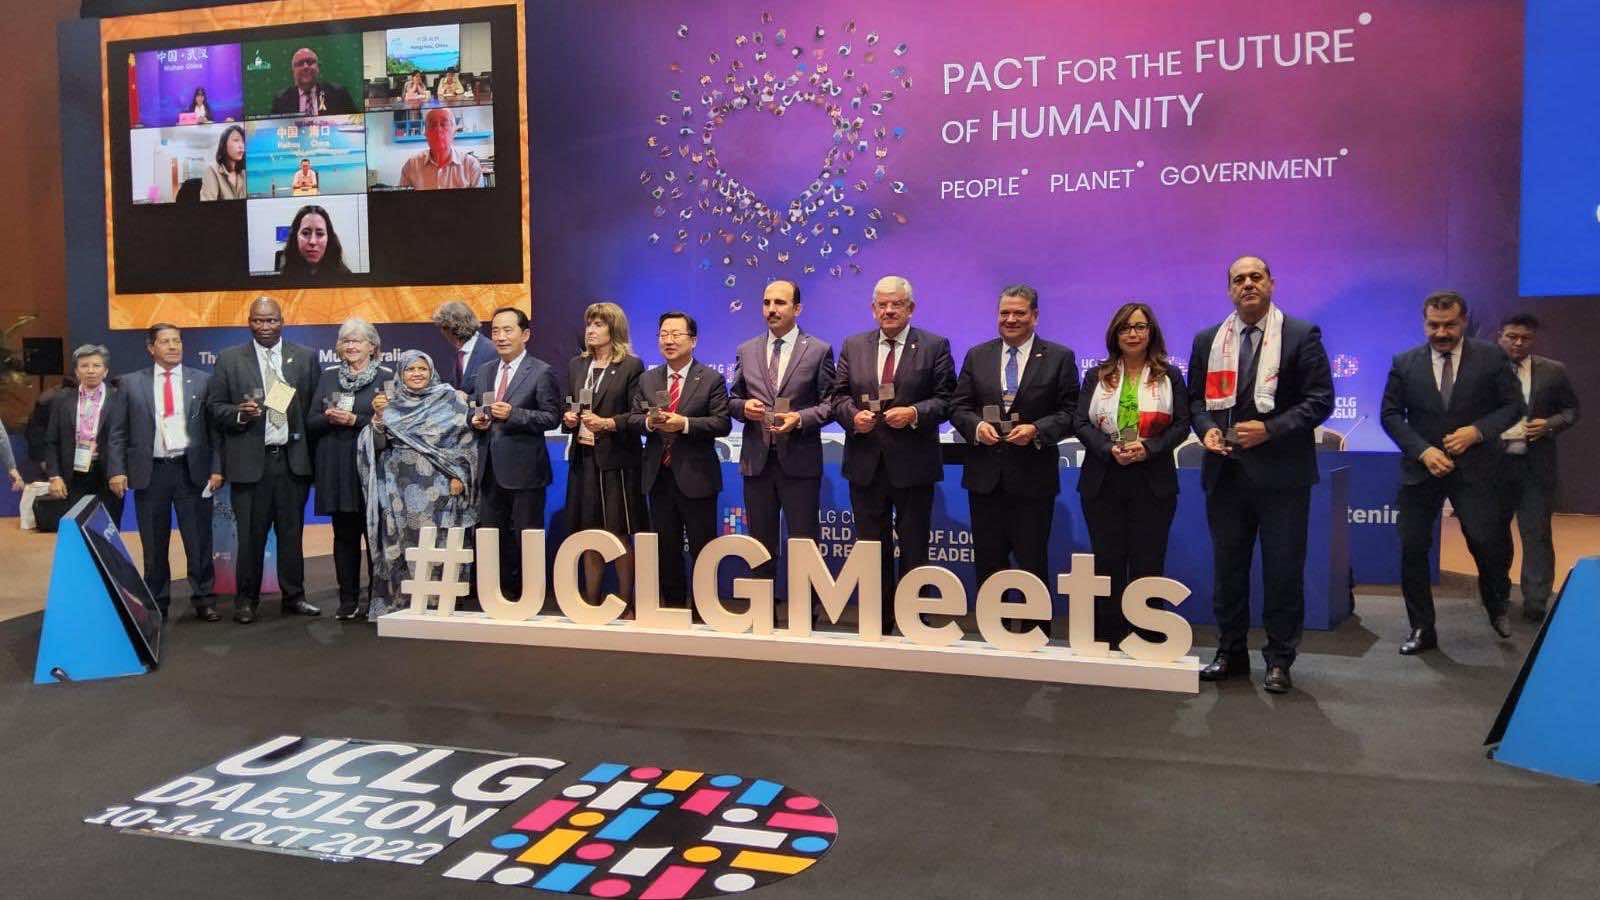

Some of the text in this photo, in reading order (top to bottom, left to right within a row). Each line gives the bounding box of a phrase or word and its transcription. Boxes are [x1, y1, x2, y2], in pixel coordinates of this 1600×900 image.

[943, 28, 1355, 95] PACT FOR THE FUTURE
[942, 92, 1204, 144] OF HUMANITY
[941, 157, 1338, 199] PEOPLE PLANET GOVERNMENT
[1335, 397, 1357, 407] CLG
[818, 509, 837, 524] LG
[821, 526, 852, 541] RLD
[928, 547, 975, 562] EADE
[401, 526, 1192, 663] #UCLGMeets
[216, 735, 567, 802] UCLG
[134, 776, 501, 839] DAEJEON
[83, 805, 444, 866] 10-14 OCT 2022
